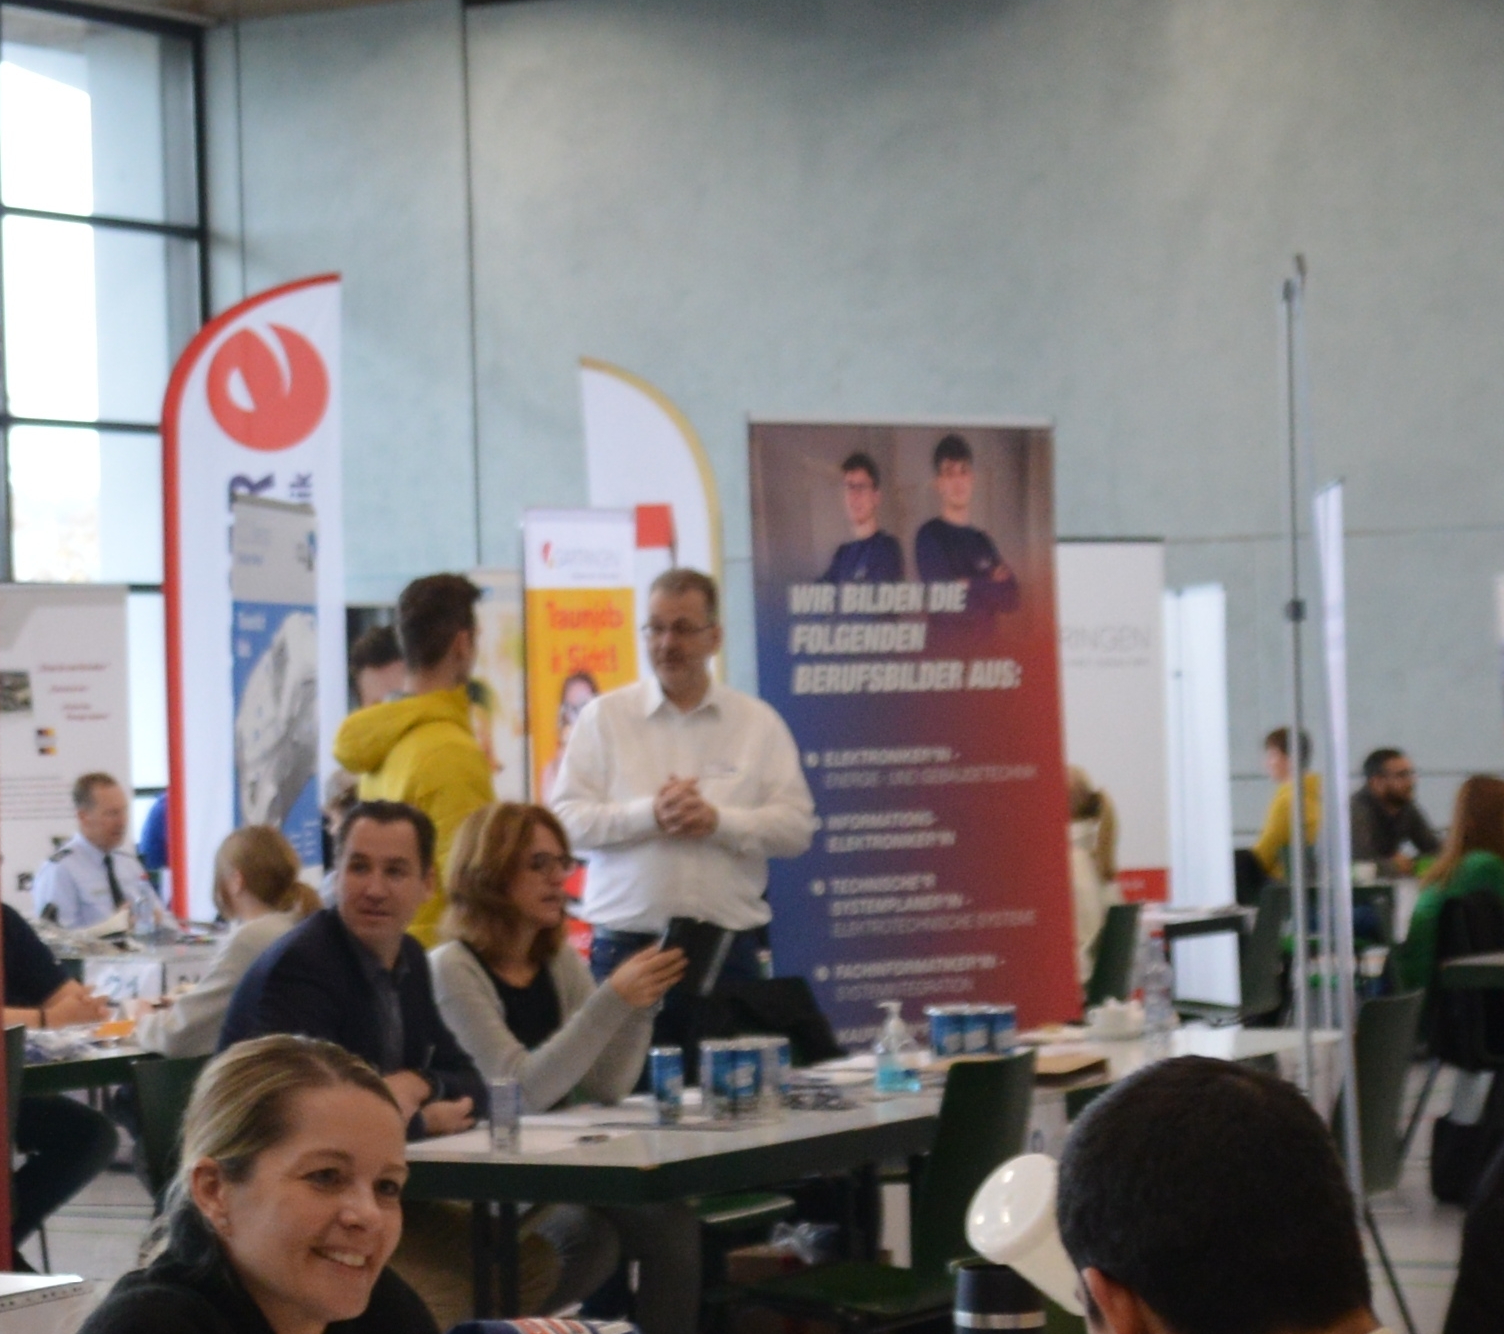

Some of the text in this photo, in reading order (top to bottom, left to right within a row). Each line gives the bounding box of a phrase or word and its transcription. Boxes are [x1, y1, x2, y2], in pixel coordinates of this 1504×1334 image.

[790, 580, 968, 615] WIR BILDEN DIE
[790, 621, 927, 654] FOLGENDEN
[793, 660, 964, 696] BERUFSBILDER
